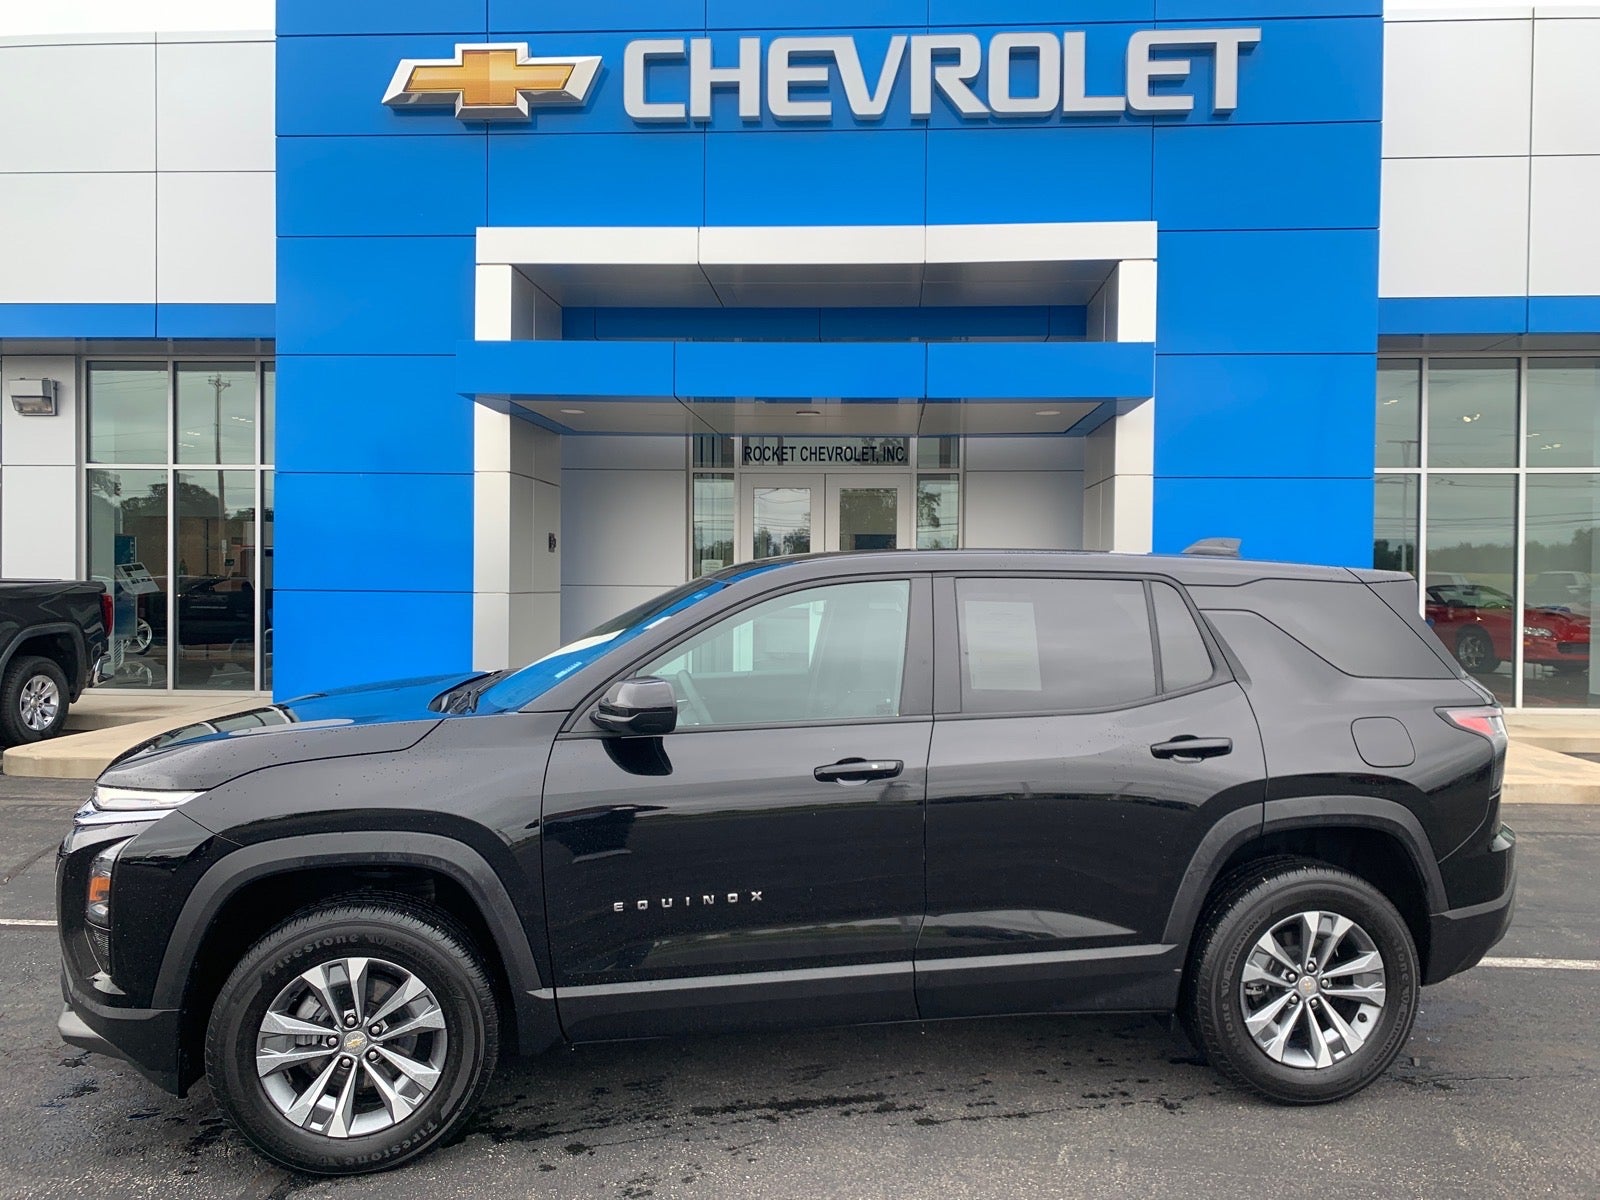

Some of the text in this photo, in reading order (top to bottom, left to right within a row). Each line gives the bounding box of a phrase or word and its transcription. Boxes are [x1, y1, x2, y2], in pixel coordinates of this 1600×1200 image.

[623, 27, 1262, 121] CHEVROLET
[743, 446, 908, 463] ROCKET CHEVROLET, INC.
[613, 890, 763, 912] EQUINOX
[264, 933, 359, 976] Firestone
[344, 1119, 439, 1167] Firestone
